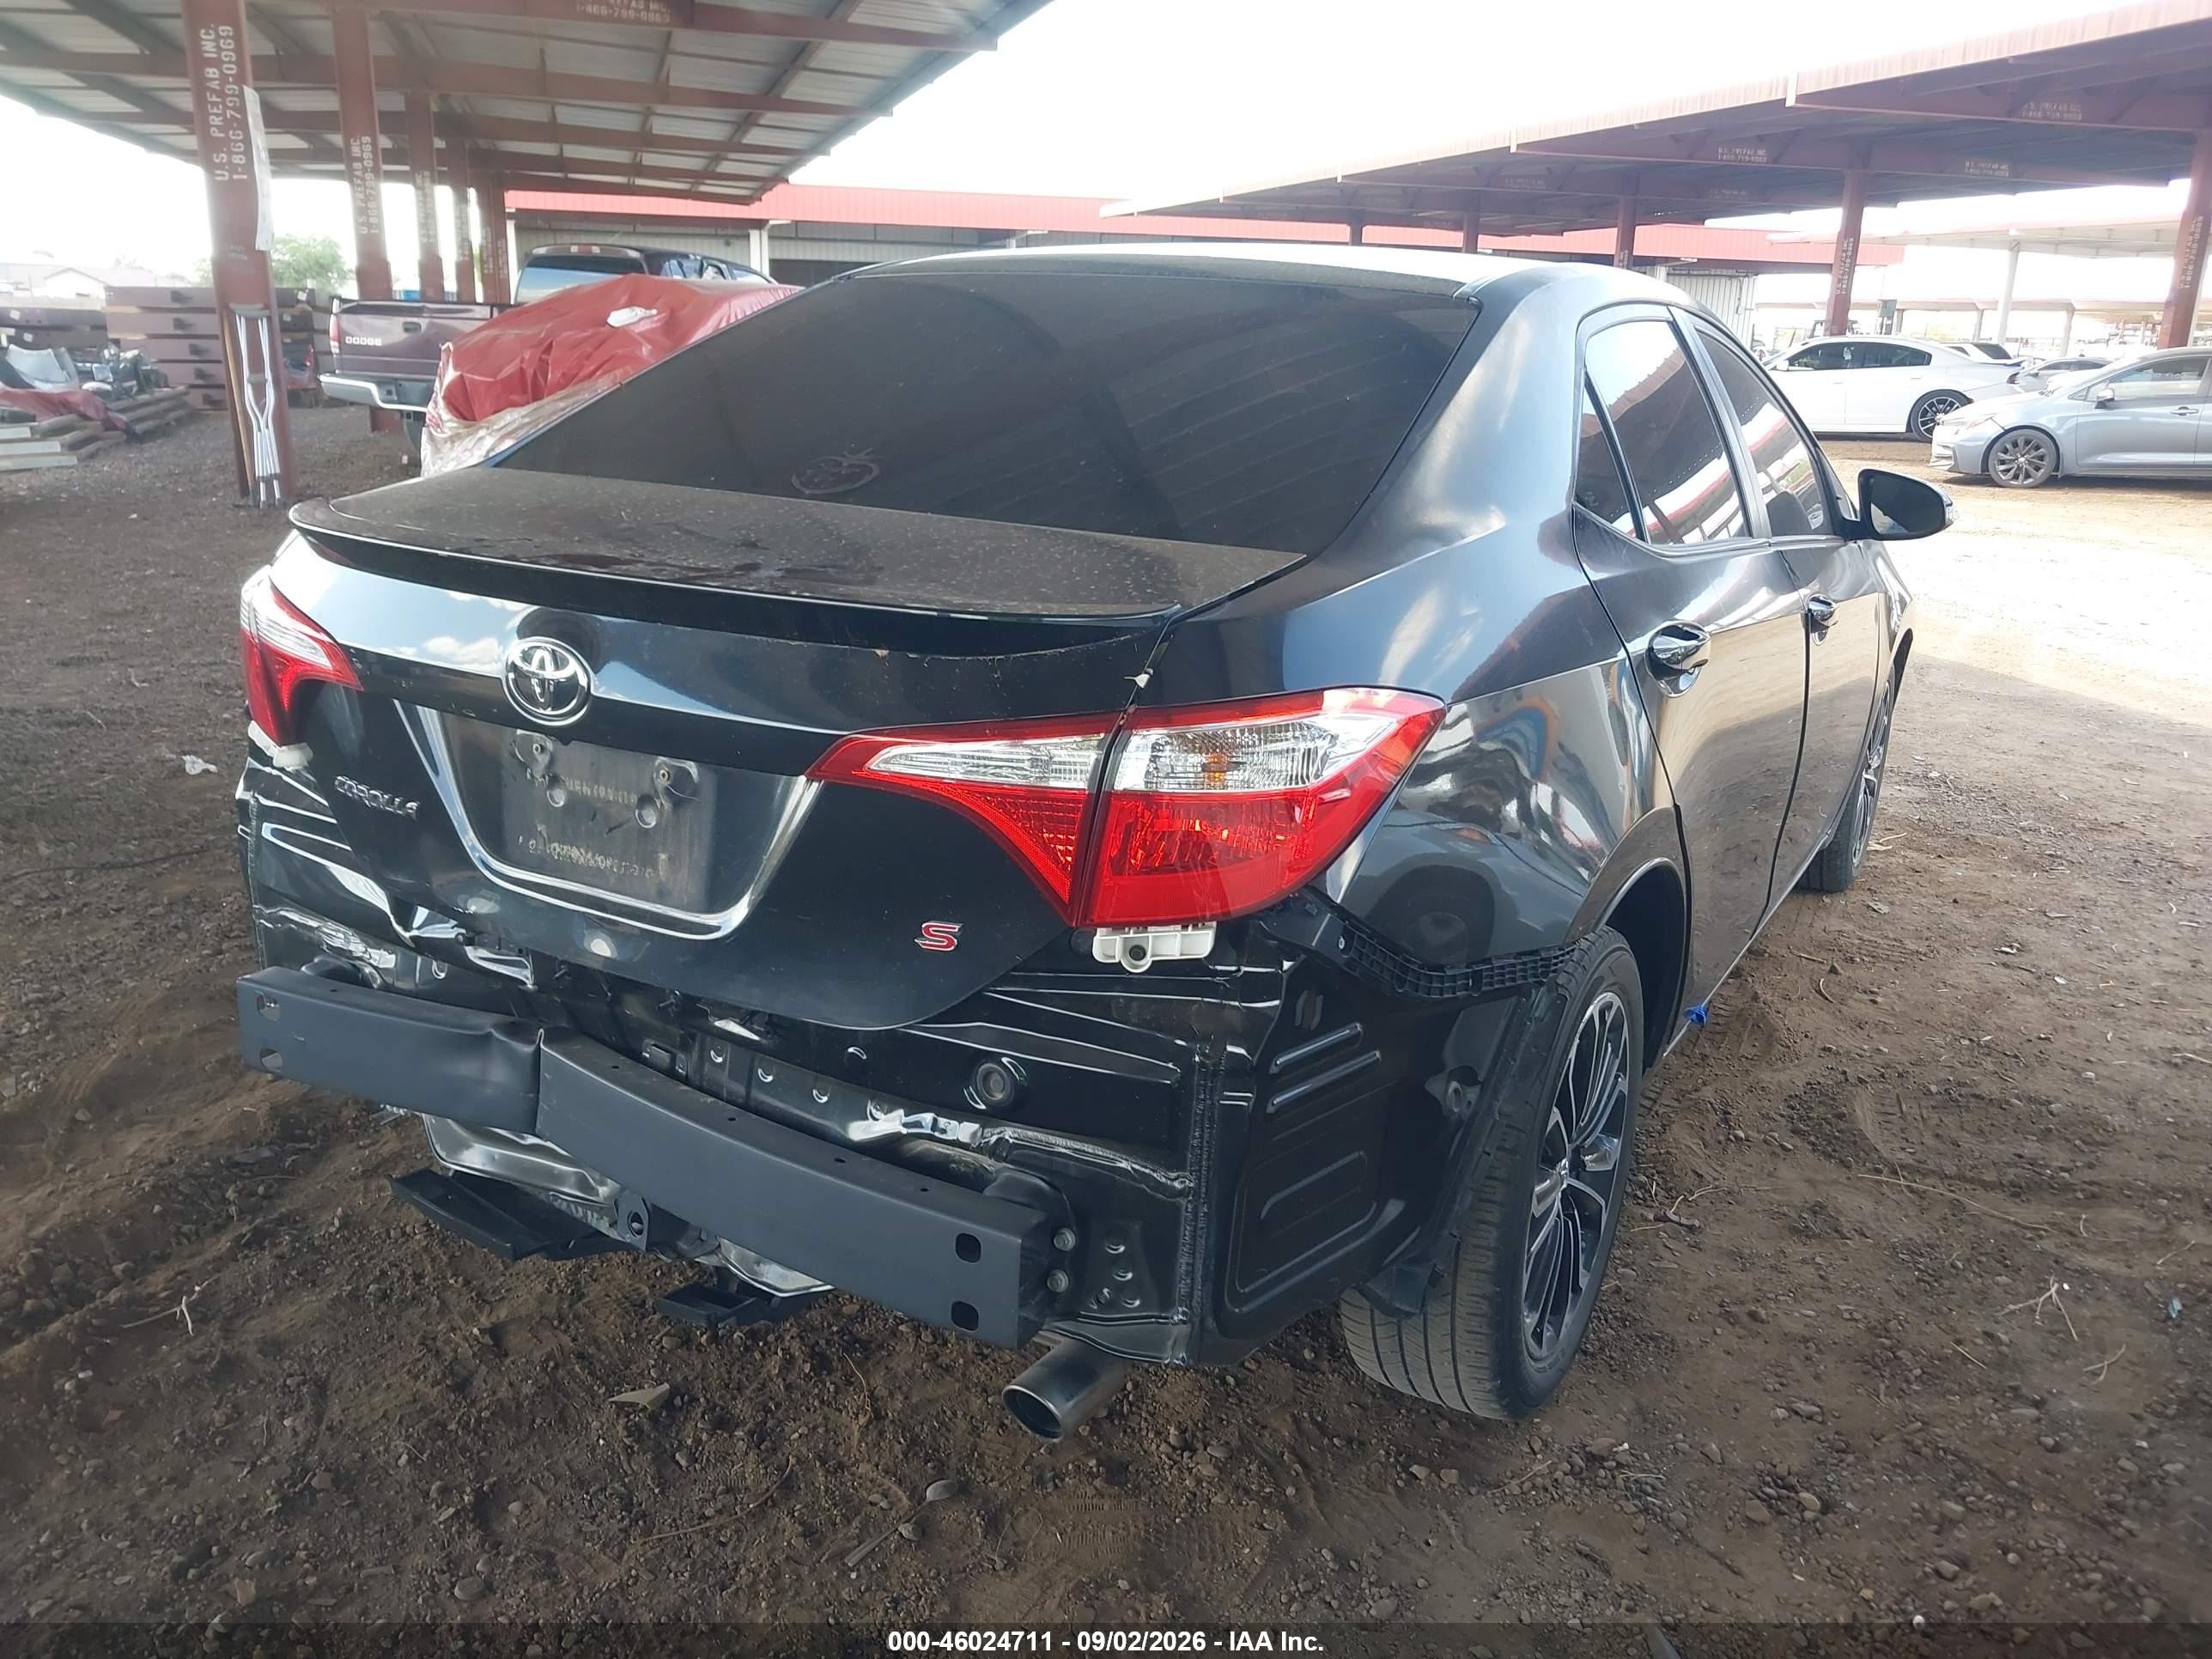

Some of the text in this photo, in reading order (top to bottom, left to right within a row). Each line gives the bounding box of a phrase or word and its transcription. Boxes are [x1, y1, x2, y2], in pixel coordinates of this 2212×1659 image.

[200, 23, 229, 181] U.S. PREFAB INC.
[219, 25, 248, 180] 1-866-799-0969
[351, 161, 366, 207] PREFAB
[345, 336, 383, 347] DODGE
[334, 775, 421, 820] COROLLA
[914, 921, 963, 951] S
